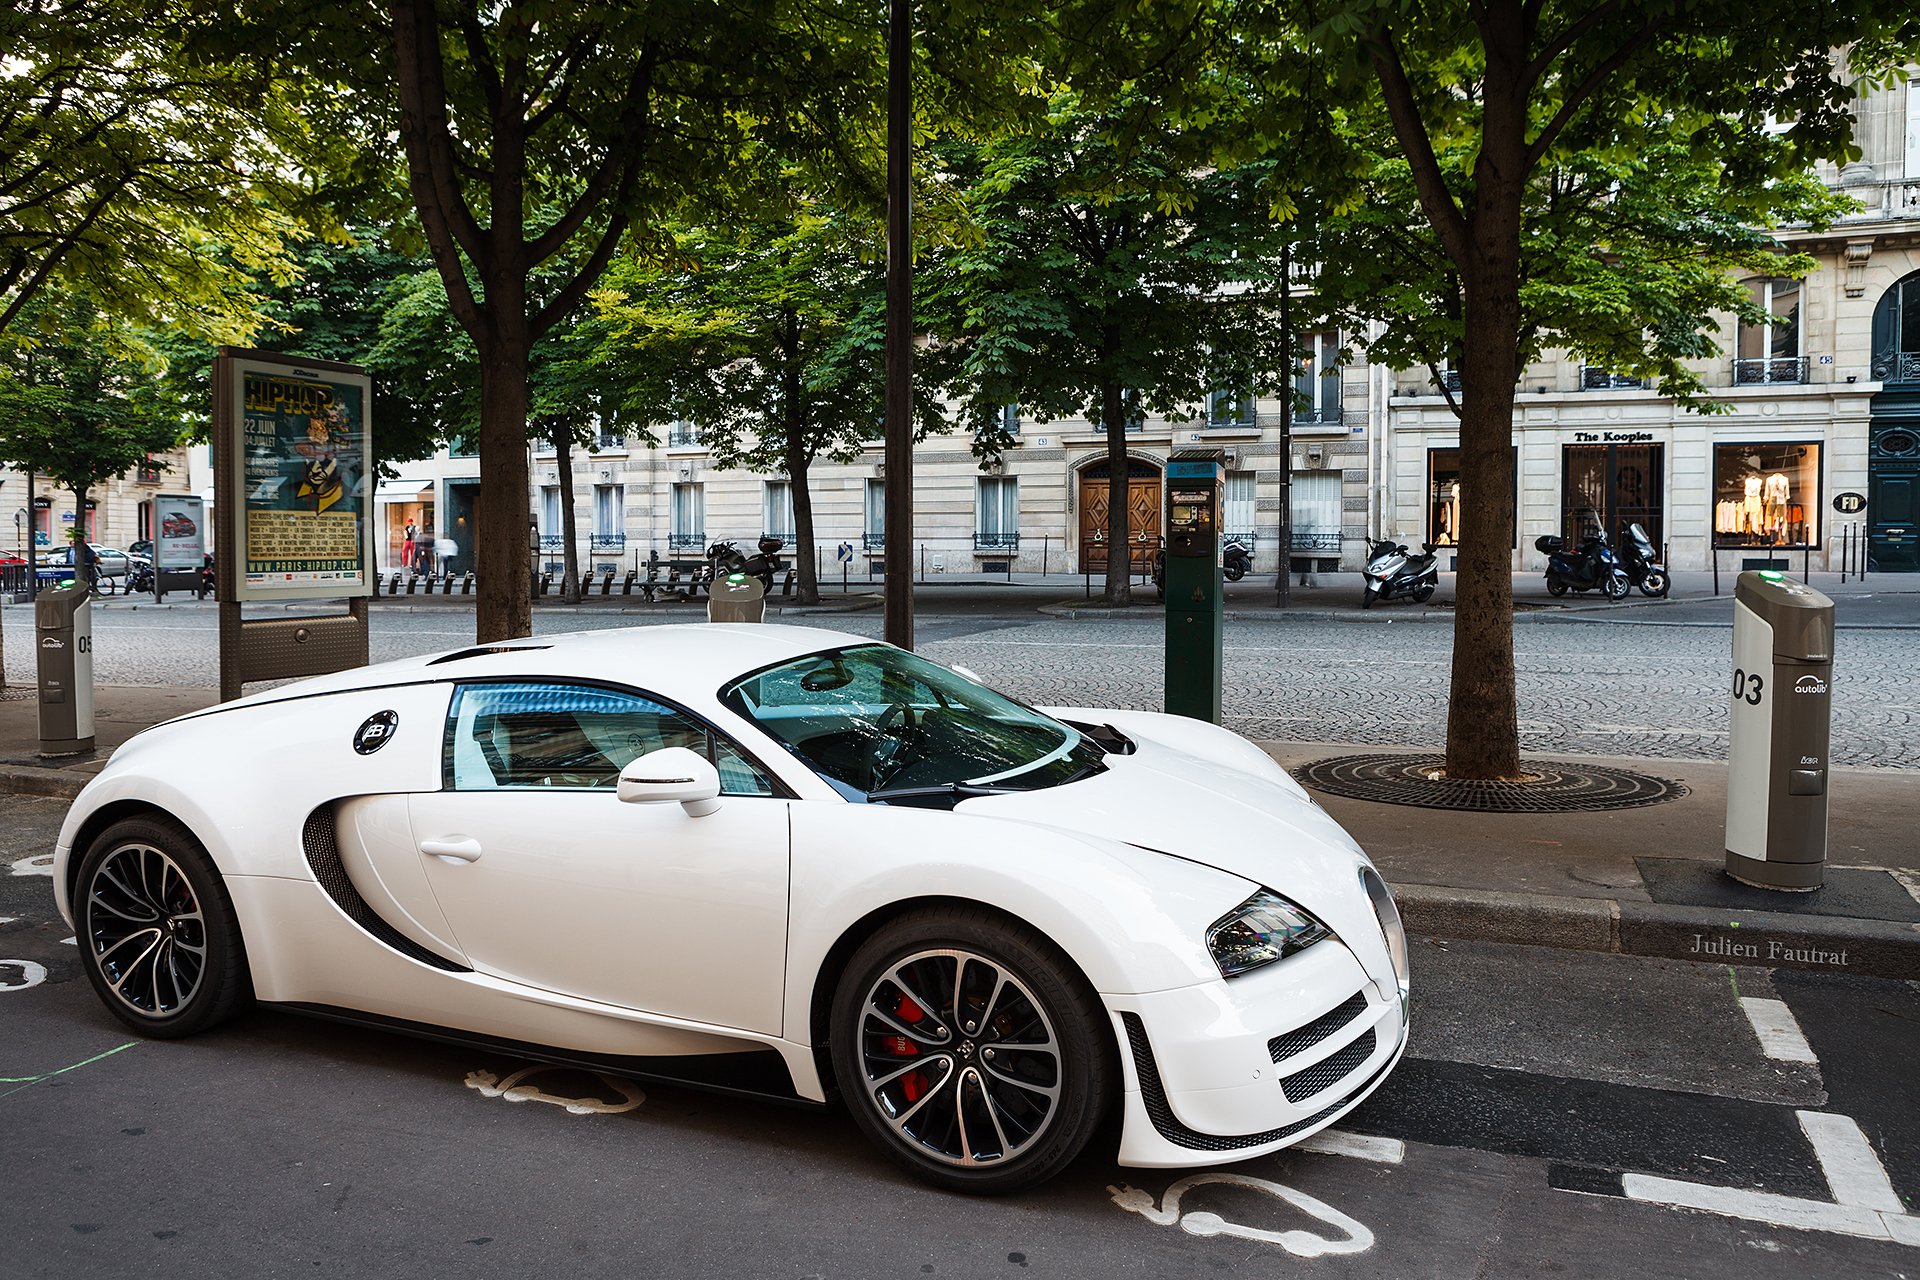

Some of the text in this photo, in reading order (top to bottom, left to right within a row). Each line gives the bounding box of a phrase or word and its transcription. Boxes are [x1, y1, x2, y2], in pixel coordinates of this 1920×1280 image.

[244, 419, 276, 434] 22 JUIN
[1574, 431, 1652, 442] The Kooples
[1842, 496, 1858, 510] FD
[248, 561, 357, 572] WWW.PARIS-HIPHOP.COM
[1733, 668, 1764, 706] 03
